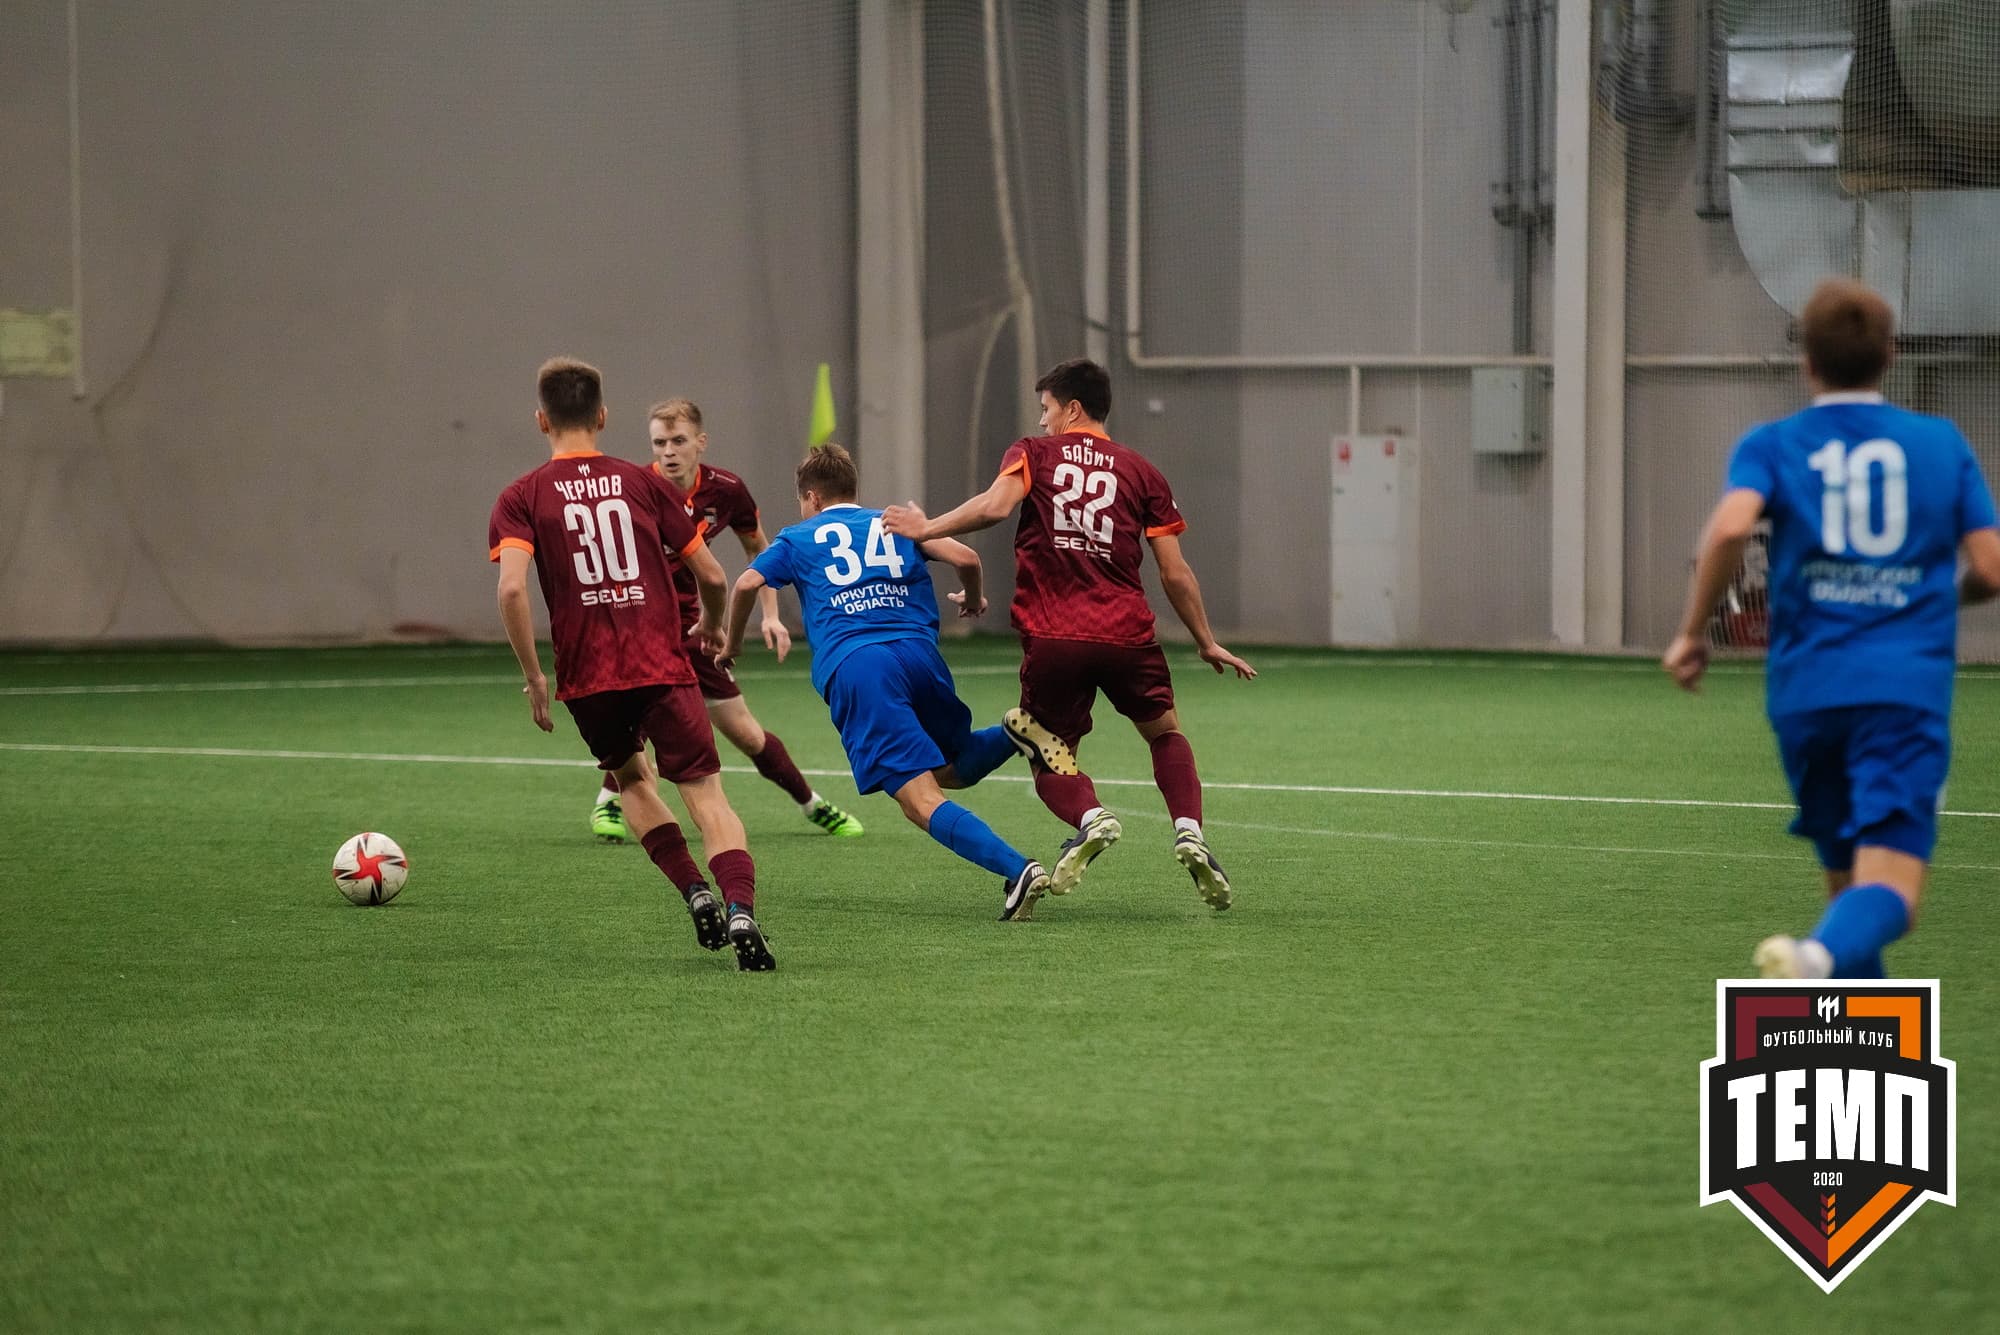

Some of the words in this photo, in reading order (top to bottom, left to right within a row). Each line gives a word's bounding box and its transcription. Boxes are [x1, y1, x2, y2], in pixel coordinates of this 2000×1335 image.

[1062, 444, 1114, 469] БАБИЧ
[554, 475, 622, 500] ЧЕРНОВ
[1808, 438, 1908, 557] 10
[1053, 463, 1117, 544] 22
[564, 499, 640, 585] 30
[814, 517, 904, 586] 34
[581, 585, 645, 606] SEUS
[830, 584, 909, 608] ИРКУТСКАЯ
[844, 596, 904, 615] ОБЛАСТЬ
[730, 919, 750, 932] NIKE
